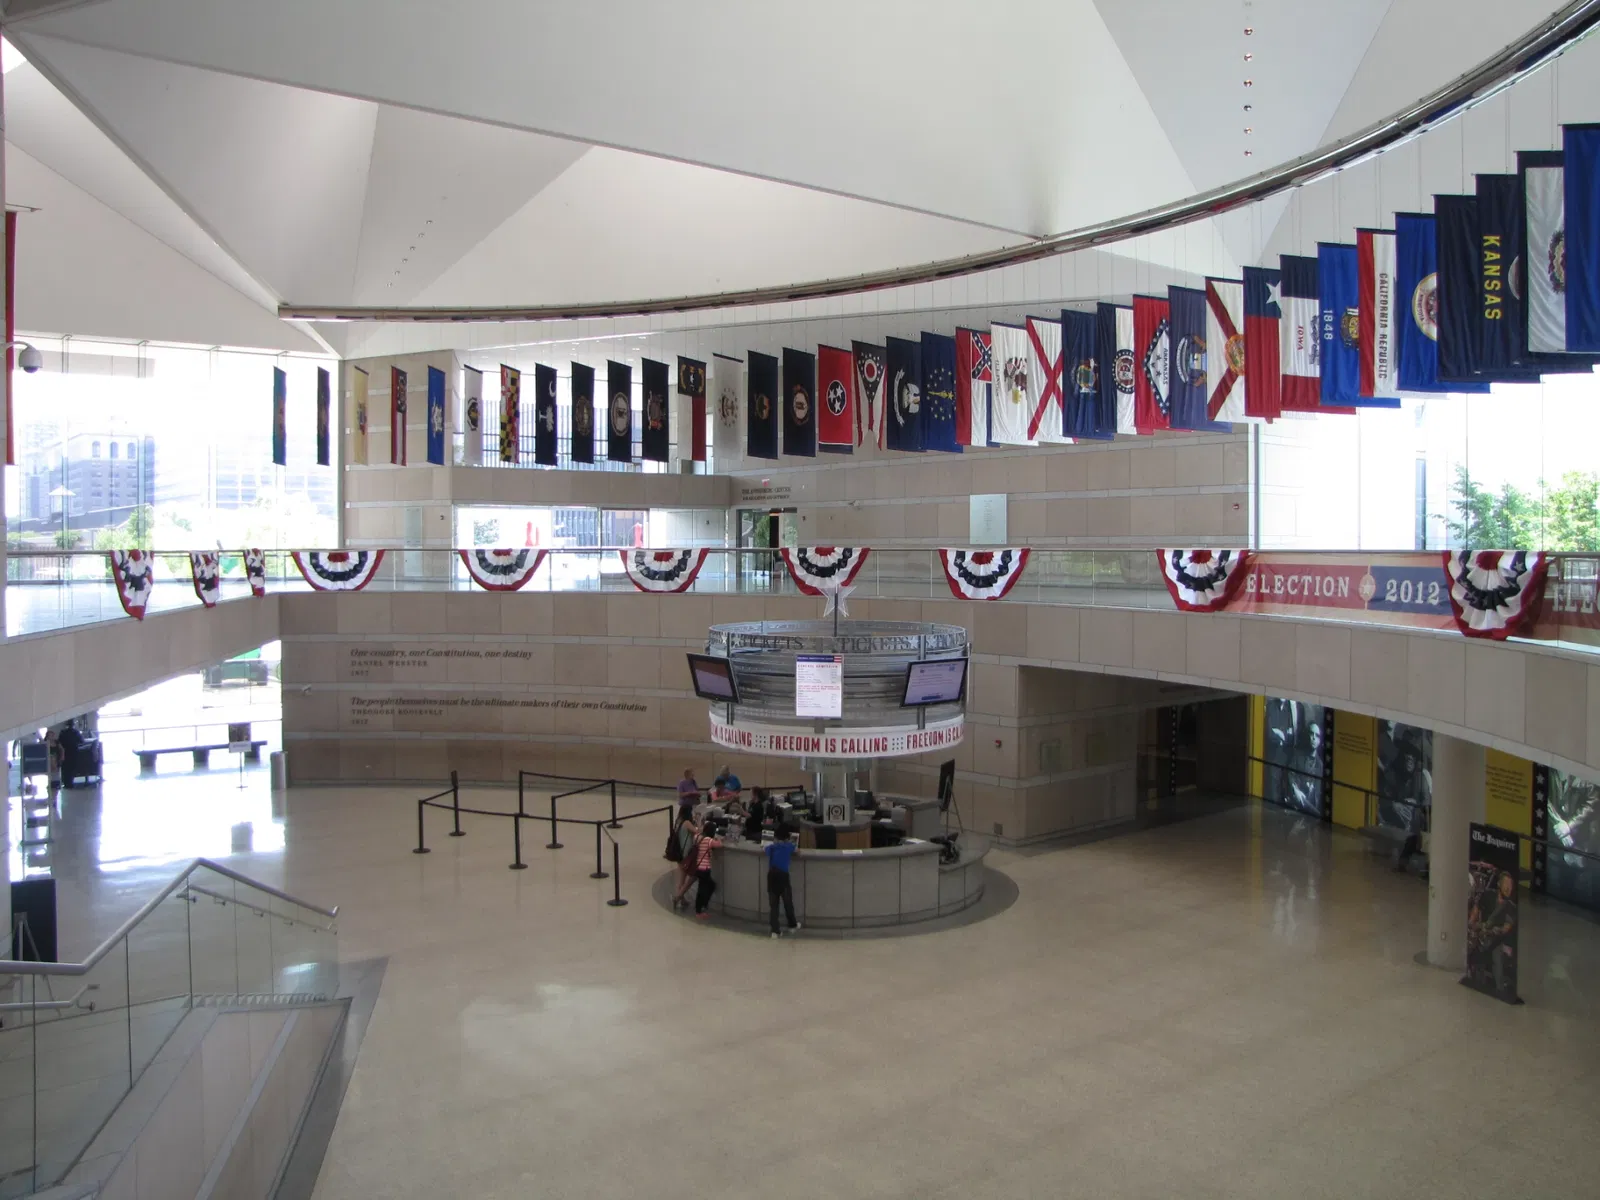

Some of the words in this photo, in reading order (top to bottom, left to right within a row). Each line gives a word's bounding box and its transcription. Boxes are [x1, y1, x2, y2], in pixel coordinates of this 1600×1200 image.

[1483, 235, 1502, 320] KANSAS
[1379, 273, 1388, 329] CALIFORNIA
[1323, 310, 1333, 340] 1848
[1378, 334, 1388, 379] REPUBLIC
[1245, 574, 1350, 598] ELECTION
[1385, 578, 1440, 606] 2012
[837, 634, 912, 652] TICKETS
[502, 650, 533, 660] destiny
[520, 698, 549, 708] makers
[550, 700, 560, 709] of
[561, 700, 580, 709] their
[600, 701, 647, 712] Constitution
[725, 727, 752, 748] CALLING
[770, 735, 820, 753] FREEDOM
[825, 738, 836, 753] IS
[841, 737, 888, 753] CALLING
[906, 731, 944, 750] FREEDOM
[1472, 830, 1486, 842] The
[1486, 833, 1516, 850] Inquirer
